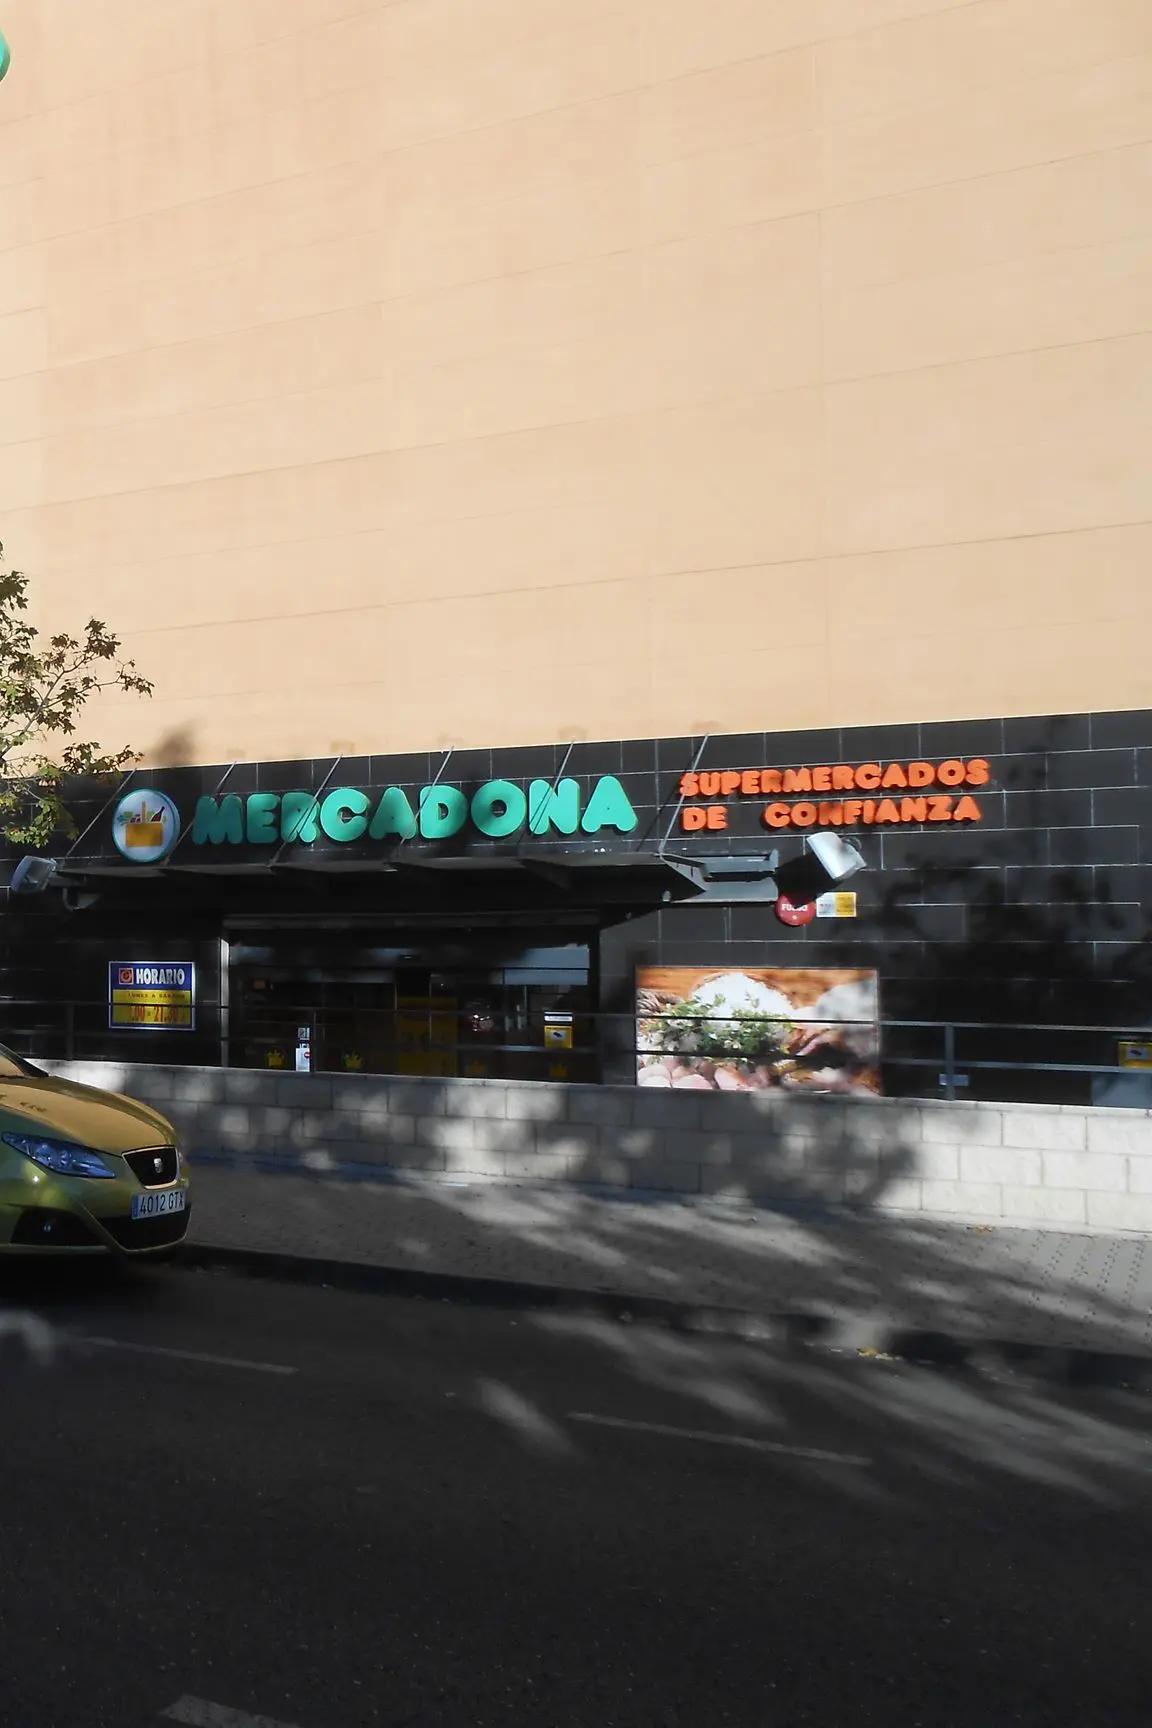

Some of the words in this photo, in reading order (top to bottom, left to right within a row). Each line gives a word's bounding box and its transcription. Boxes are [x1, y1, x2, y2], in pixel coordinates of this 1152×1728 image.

[680, 759, 991, 797] SUPERMERCADOS
[192, 775, 638, 844] MERCADONA
[682, 806, 728, 831] DE
[764, 796, 982, 828] CONFIANZA
[136, 968, 185, 985] HORARIO
[140, 1195, 166, 1214] 4012
